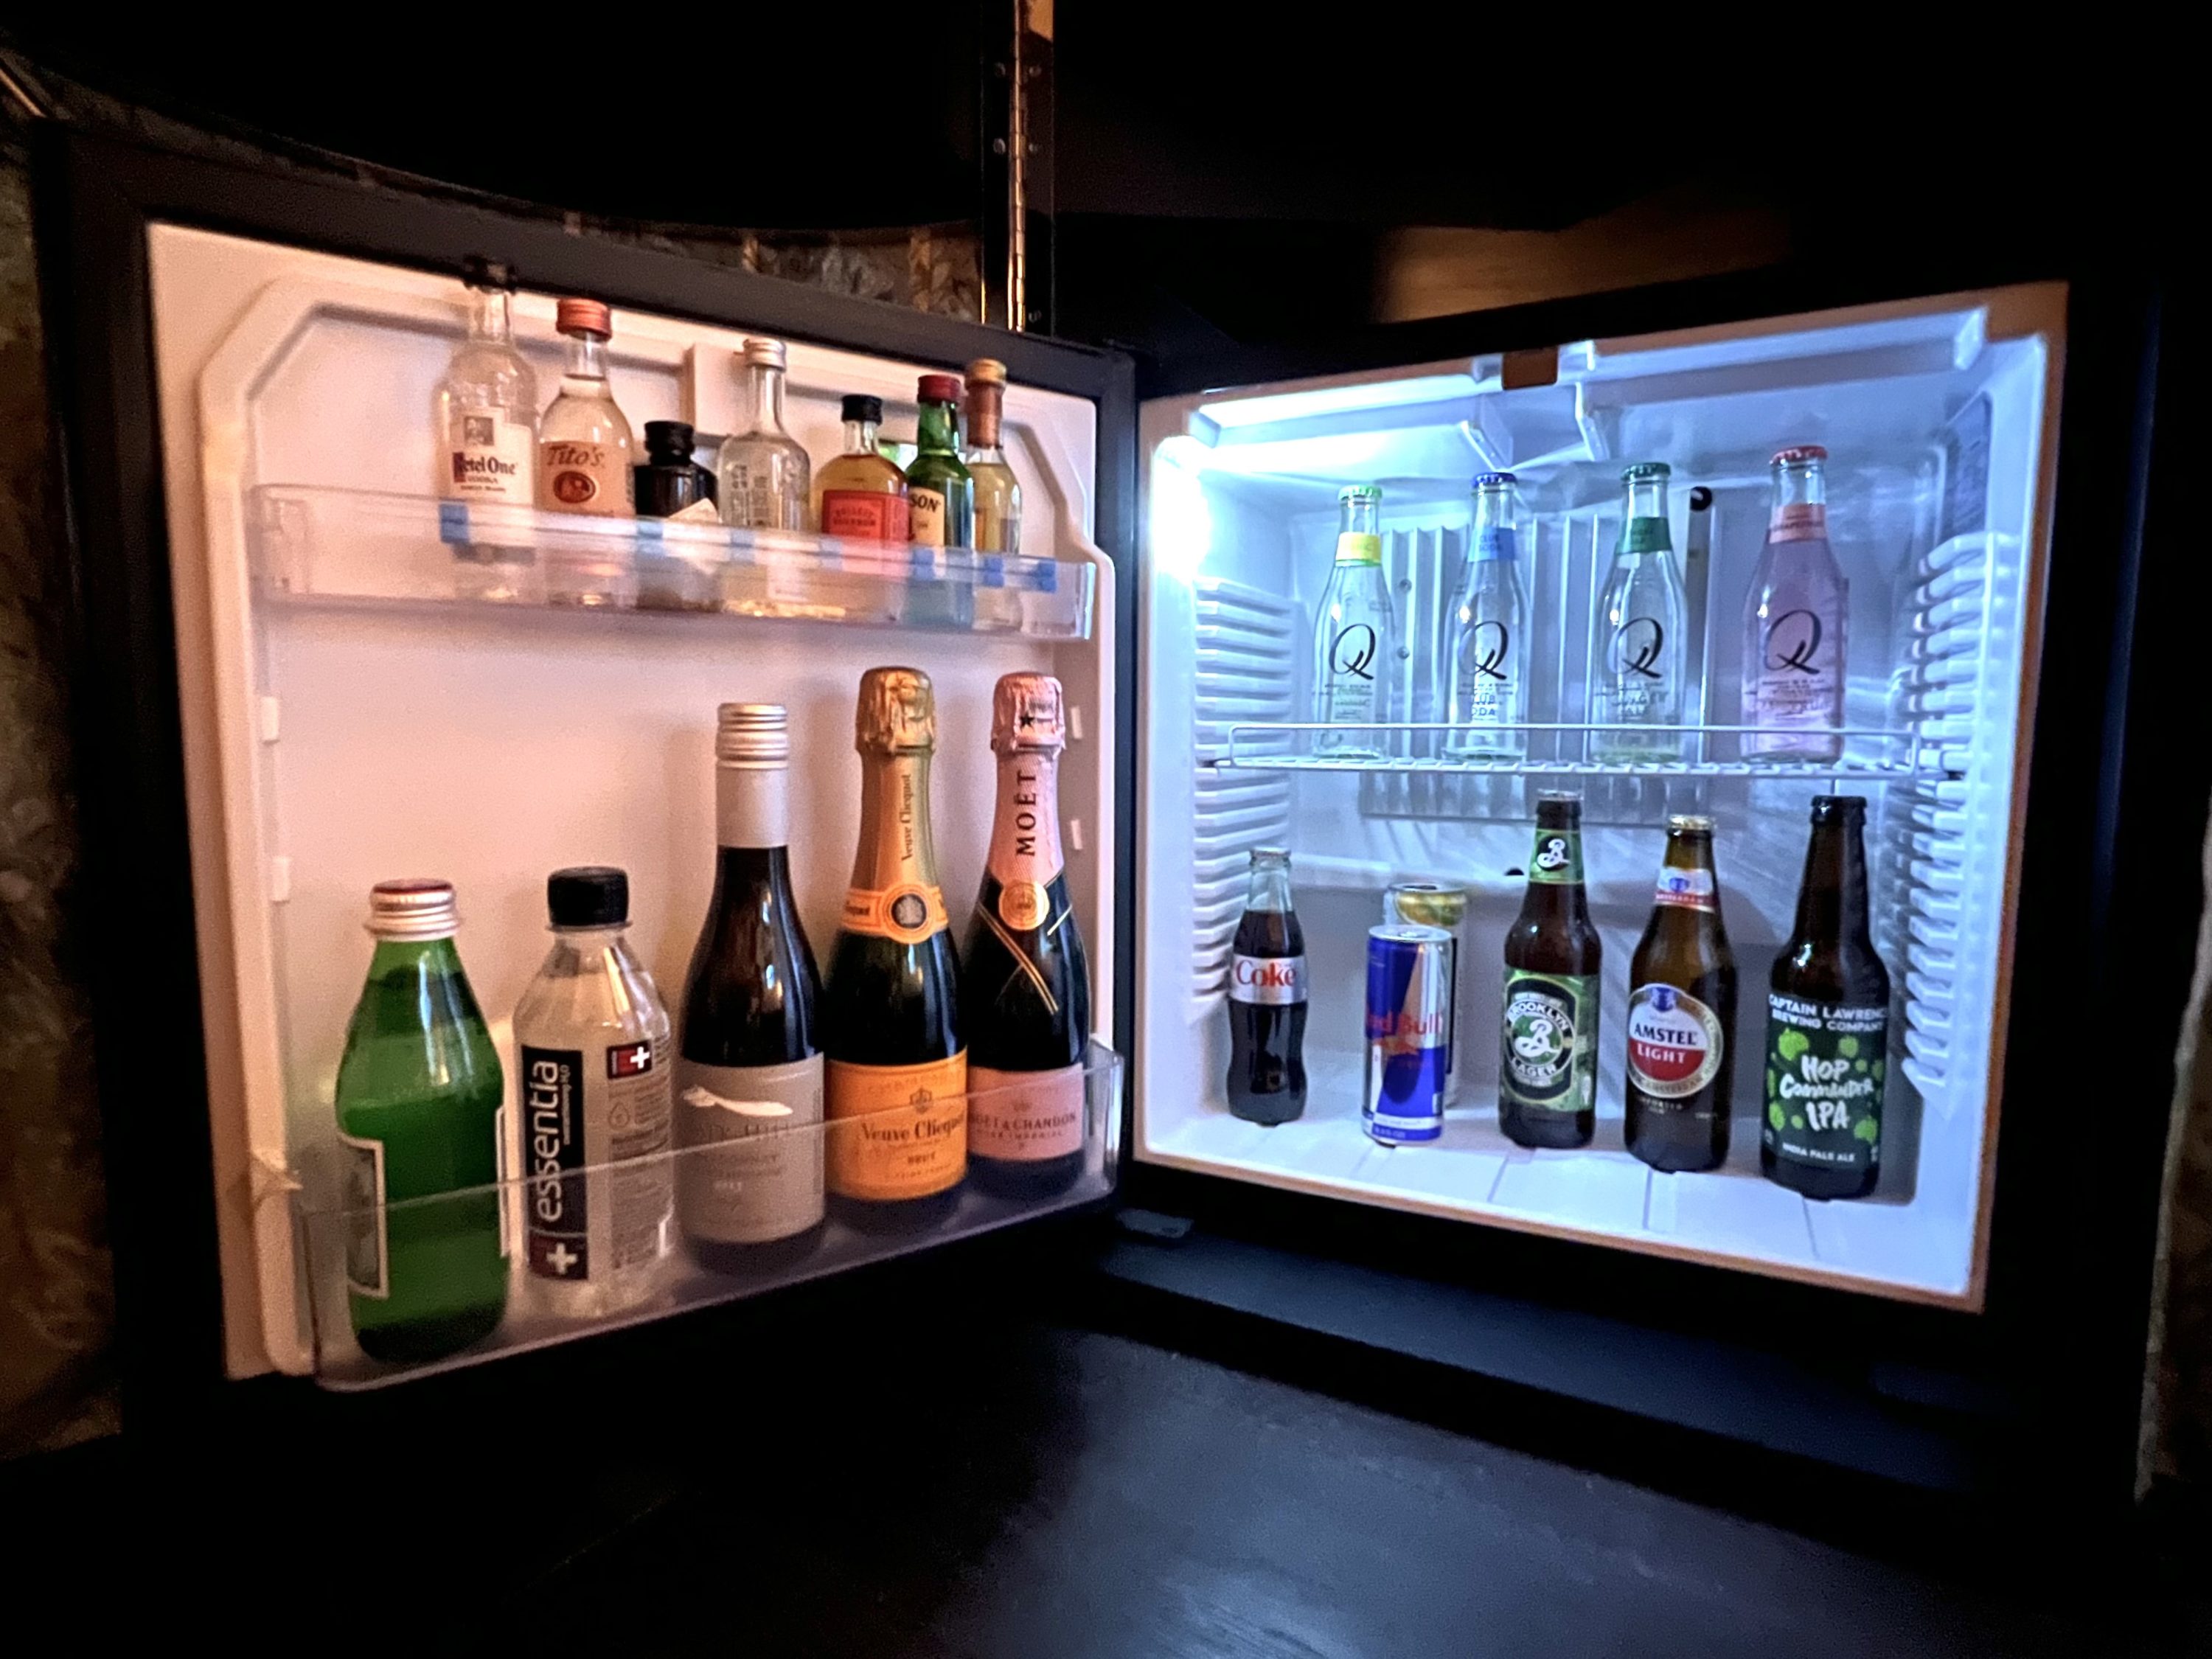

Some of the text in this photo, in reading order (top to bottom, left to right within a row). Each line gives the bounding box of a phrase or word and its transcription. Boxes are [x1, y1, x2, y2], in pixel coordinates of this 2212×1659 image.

[487, 456, 516, 476] One
[547, 445, 605, 467] Tito's
[1329, 623, 1376, 680] Q
[1458, 621, 1509, 680] Q
[1607, 617, 1663, 678] Q
[1764, 609, 1821, 675] Q
[901, 827, 914, 861] Veuve
[1236, 959, 1297, 987] Coke
[1506, 1001, 1570, 1031] BROOKLYN
[1769, 994, 1888, 1020] CAPTAIN LAWRENC
[1772, 1008, 1822, 1029] BREWING
[1633, 1022, 1697, 1046] AMSTEL
[1637, 1043, 1686, 1064] LIGHT
[1801, 1054, 1849, 1084] HOP
[1013, 1111, 1076, 1130] CHANDON
[1806, 1101, 1850, 1132] IPA
[529, 1060, 563, 1222] essentia
[859, 1121, 910, 1142] Veuve
